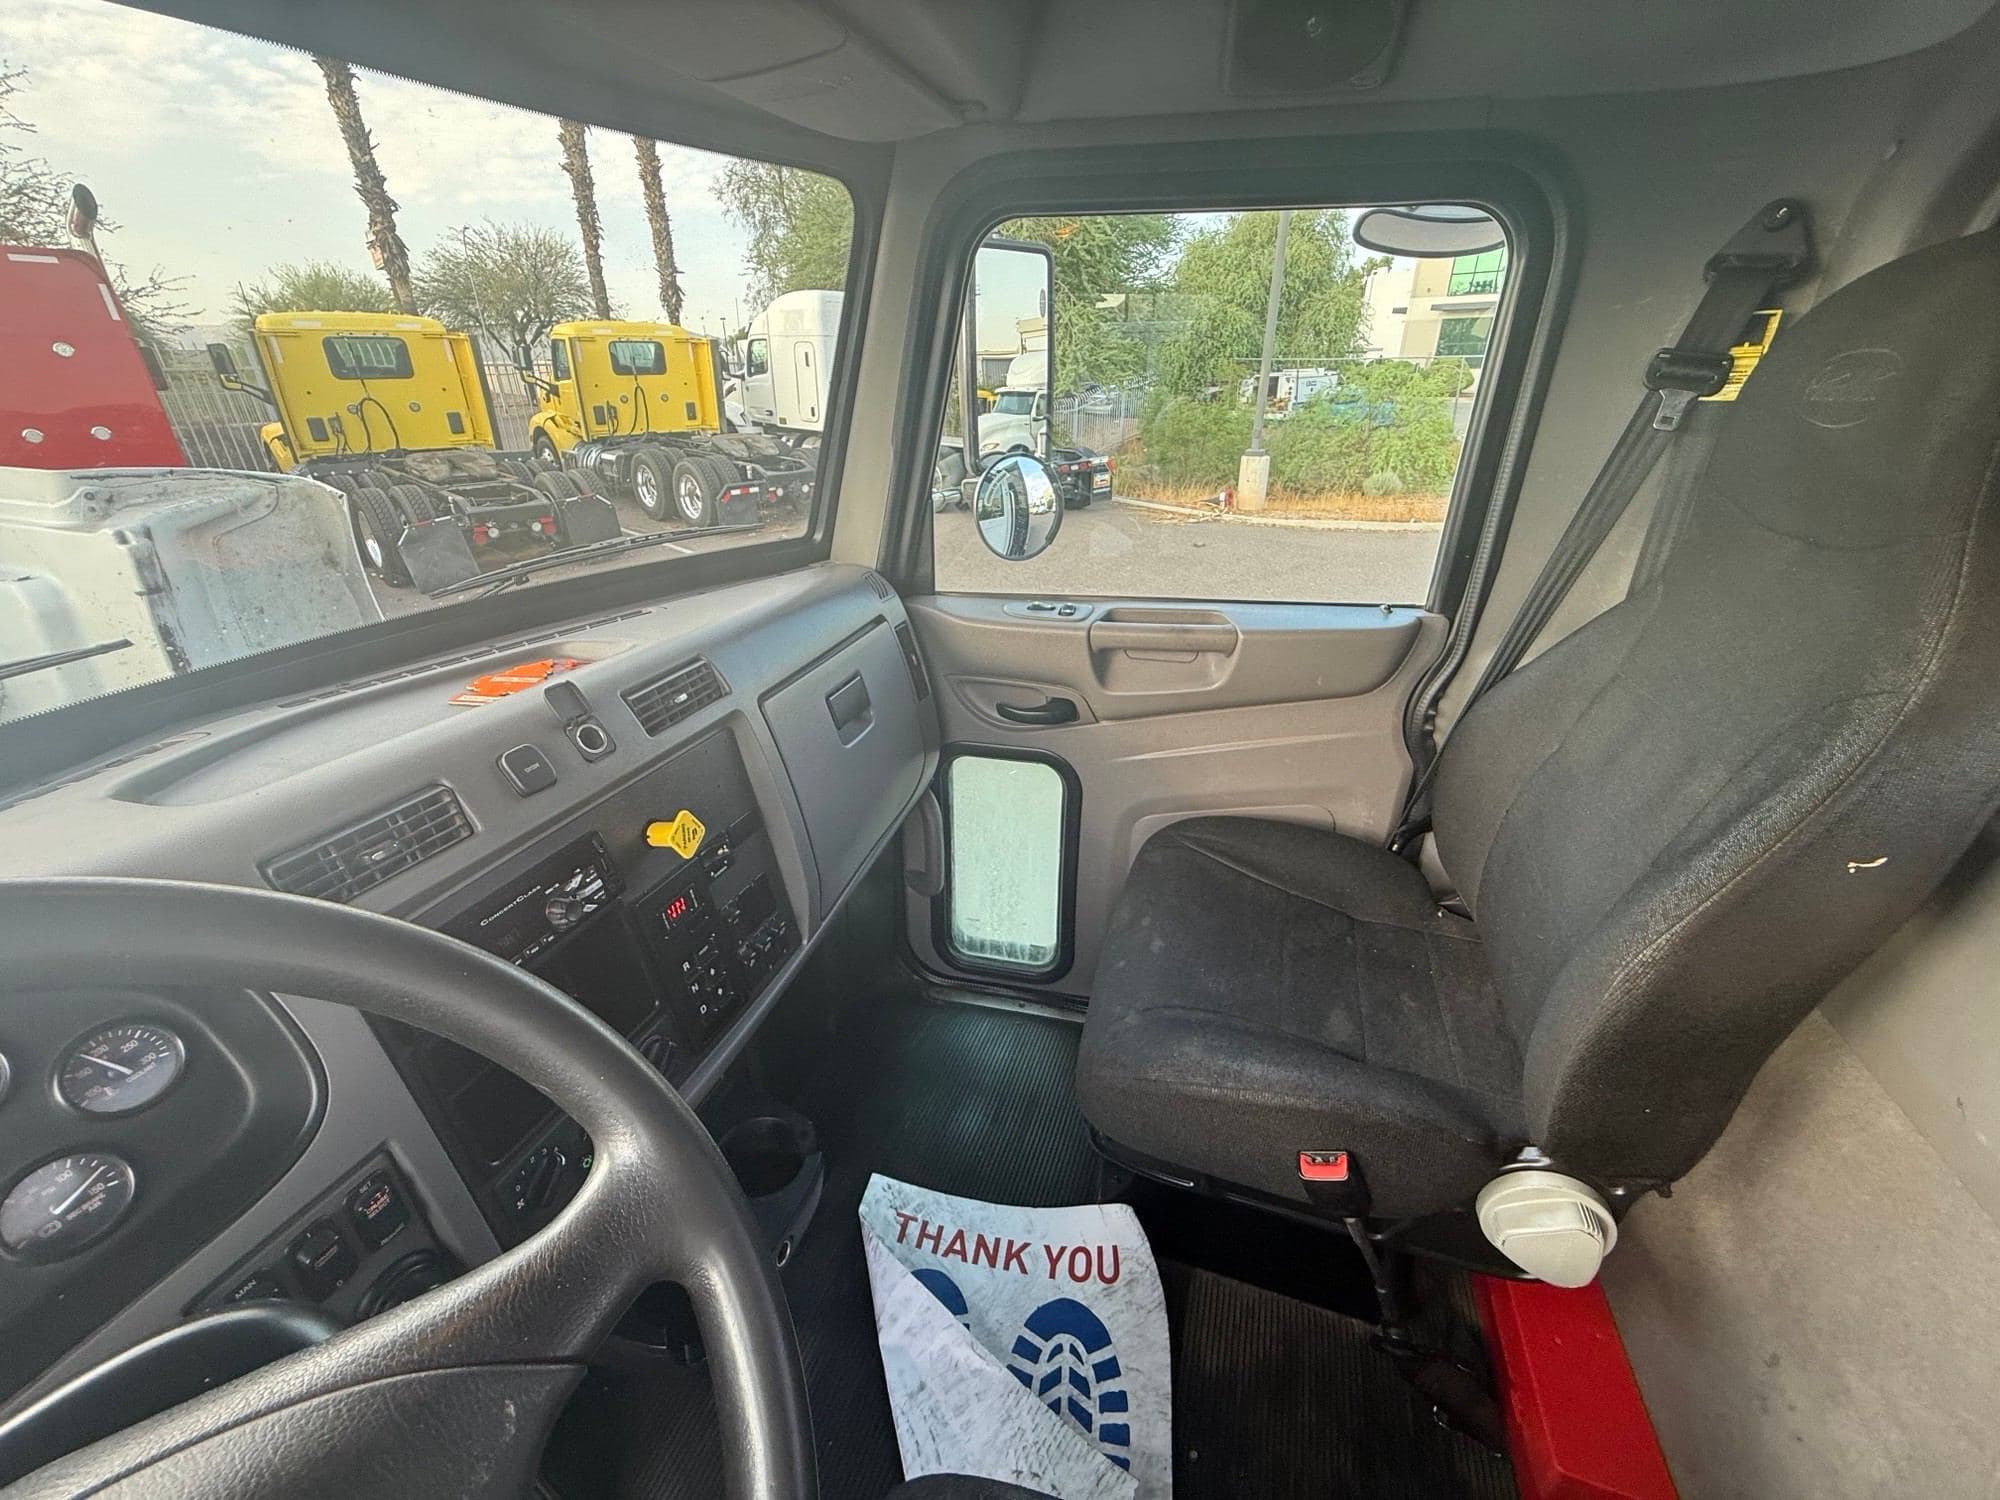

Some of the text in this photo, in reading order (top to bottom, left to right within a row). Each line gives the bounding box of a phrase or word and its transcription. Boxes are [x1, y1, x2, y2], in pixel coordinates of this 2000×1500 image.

[682, 961, 690, 972] R
[55, 1169, 73, 1183] 100
[896, 1211, 1121, 1285] THANK YOU
